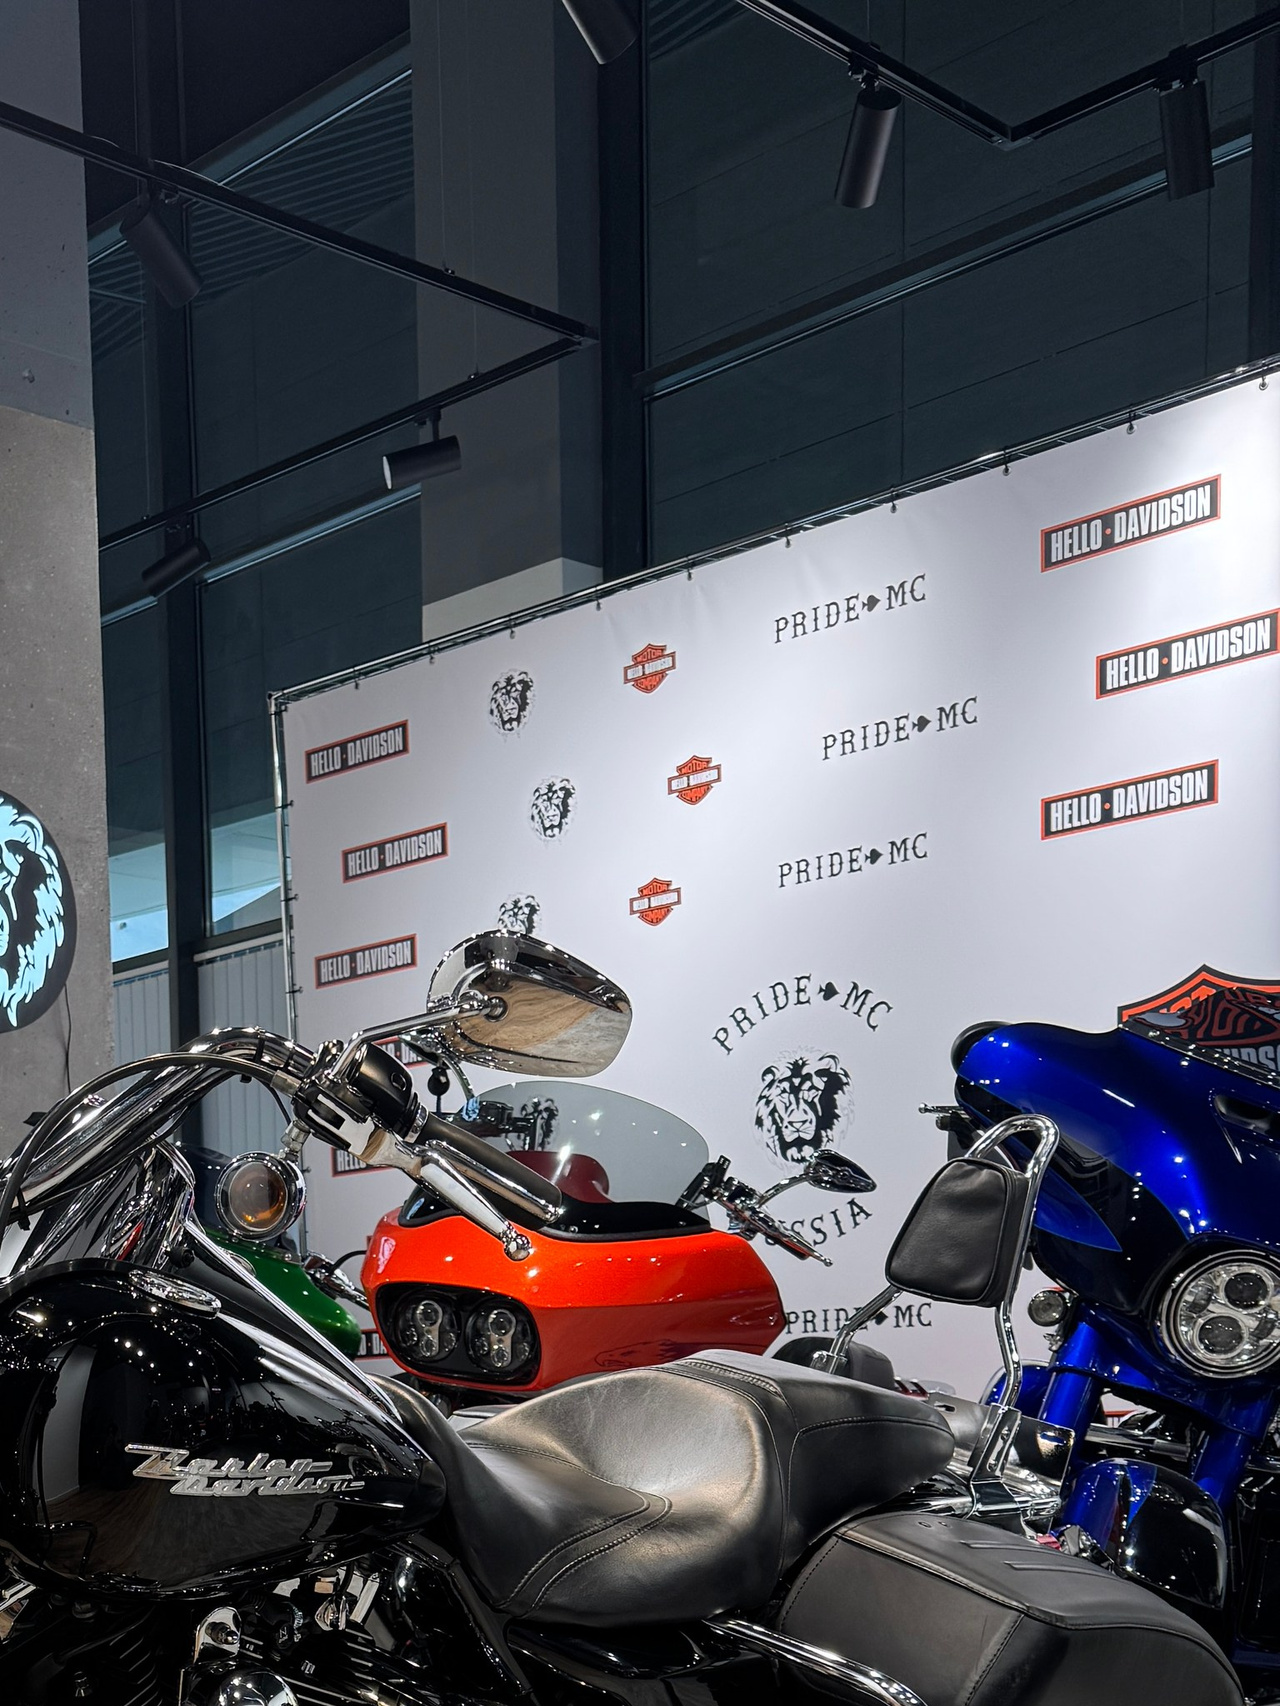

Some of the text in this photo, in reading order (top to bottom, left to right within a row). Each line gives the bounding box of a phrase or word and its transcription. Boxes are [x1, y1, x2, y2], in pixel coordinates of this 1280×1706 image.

[1051, 485, 1211, 563] HELLO DAVIDSON
[774, 574, 927, 644] PRIDE MC
[1106, 617, 1271, 690] HELLO DAVIDSON
[310, 728, 404, 777] HELLO DAVIDSON
[822, 696, 978, 761] PRIDE MC
[1050, 769, 1208, 832] HELLO DAVIDSON
[348, 830, 443, 877] HELLO DAVIDSON
[778, 832, 928, 888] PRIDE MC
[320, 940, 412, 983] HELLO DAVIDSON
[712, 973, 894, 1056] PRIDE MC
[893, 1303, 932, 1328] MC
